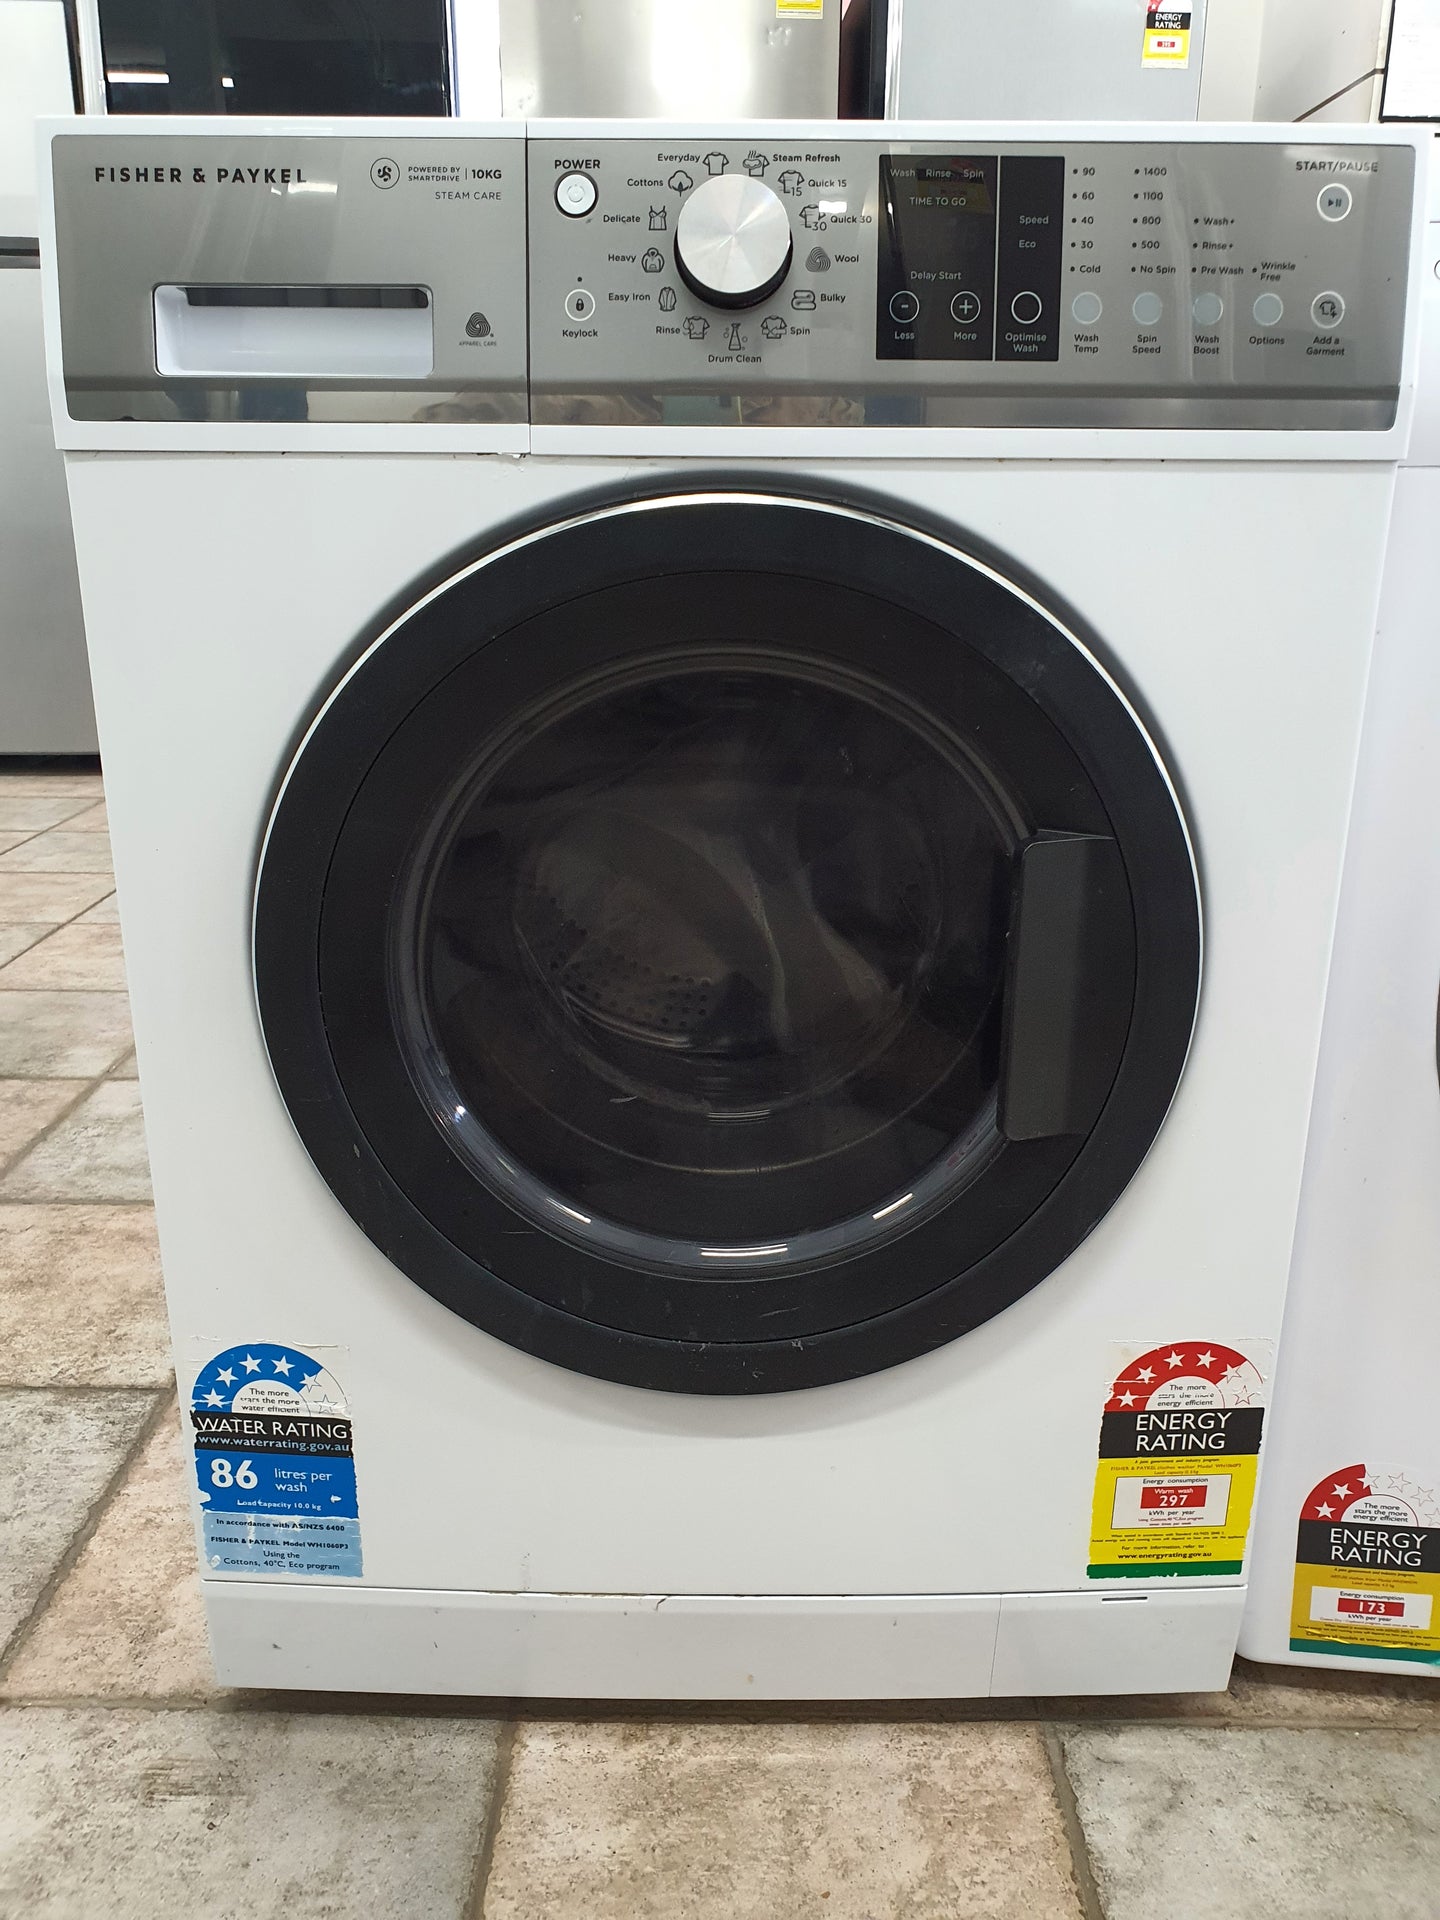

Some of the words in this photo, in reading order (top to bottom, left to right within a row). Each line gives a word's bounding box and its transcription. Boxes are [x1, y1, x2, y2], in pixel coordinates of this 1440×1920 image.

[1155, 13, 1182, 21] ENERGY
[1155, 21, 1181, 29] RATING
[658, 153, 700, 164] Everyday
[772, 154, 802, 163] Steam
[805, 154, 840, 163] Refresh
[554, 159, 600, 169] POWER
[1296, 161, 1379, 173] START/PAUSE
[95, 167, 182, 182] FISHER
[192, 167, 205, 182] &
[217, 168, 307, 183] PAYKEL
[471, 169, 502, 179] 10KG
[890, 169, 916, 177] Wash
[926, 169, 951, 178] Rinse
[963, 169, 984, 179] Spin
[1082, 167, 1095, 176] 90
[1143, 167, 1167, 176] 1400
[627, 178, 663, 187] Cottons
[808, 179, 834, 188] Quick
[836, 179, 847, 188] 15
[435, 191, 470, 200] STEAM
[474, 191, 502, 200] CARE
[790, 187, 802, 197] 15
[1081, 192, 1094, 200] 60
[1142, 191, 1163, 200] 1100
[910, 197, 932, 205] TIME
[935, 197, 949, 205] TO
[951, 197, 967, 206] GO
[603, 214, 640, 223] Delicate
[830, 215, 857, 224] Quick
[859, 215, 872, 224] 30
[1019, 215, 1049, 226] Speed
[1081, 216, 1094, 225] 40
[1141, 216, 1161, 225] 800
[812, 222, 827, 231] 30
[1018, 240, 1037, 248] Eco
[1080, 241, 1094, 249] 30
[1141, 241, 1160, 249] 500
[608, 254, 636, 264] Heavy
[834, 254, 859, 263] Wool
[1079, 265, 1101, 273] Cold
[1140, 265, 1154, 274] No
[1156, 265, 1176, 275] Spin
[1201, 266, 1216, 274] Pre
[1219, 266, 1244, 275] Wash
[1261, 262, 1296, 271] Wrinkle
[910, 271, 937, 281] Delay
[938, 272, 961, 280] Start
[1260, 273, 1281, 281] Free
[608, 293, 629, 303] Easy
[632, 293, 650, 301] Iron
[820, 293, 846, 303] Bulky
[562, 329, 598, 339] Keylock
[655, 326, 681, 335] Rinse
[790, 327, 811, 337] Spin
[894, 331, 915, 340] Less
[953, 332, 977, 340] More
[1005, 332, 1047, 342] Optimise
[1074, 334, 1099, 342] Wash
[1137, 334, 1157, 344] Spin
[1195, 335, 1219, 344] Wash
[1249, 336, 1285, 345] Options
[1313, 336, 1332, 345] Add
[1013, 344, 1038, 352] Wash
[1074, 345, 1099, 355] Temp
[1132, 345, 1161, 355] Speed
[1193, 346, 1219, 354] Boost
[1306, 347, 1345, 356] Garment
[708, 355, 732, 363] Drum
[735, 354, 762, 363] Clean
[249, 1388, 265, 1396] The
[1136, 1412, 1232, 1431] ENERGY
[197, 1417, 268, 1435] WATER
[272, 1421, 348, 1439] RATING
[198, 1436, 350, 1452] www.waterrating.gov.au
[1136, 1432, 1226, 1452] RATING
[211, 1458, 259, 1490] 86
[274, 1468, 307, 1480] litres
[311, 1472, 333, 1483] per
[275, 1482, 308, 1493] wash
[1159, 1494, 1188, 1506] 297
[1379, 1515, 1408, 1523] efficient
[226, 1519, 271, 1528] accordance
[326, 1524, 345, 1532] 6400
[211, 1536, 239, 1544] FISHER
[1330, 1528, 1428, 1549] ENERGY
[263, 1550, 285, 1559] Using
[287, 1551, 300, 1559] the
[1331, 1545, 1422, 1567] RATING
[223, 1557, 260, 1566] Cottons,
[306, 1562, 340, 1571] program
[1363, 1593, 1405, 1601] consumption
[1359, 1601, 1386, 1614] 173
